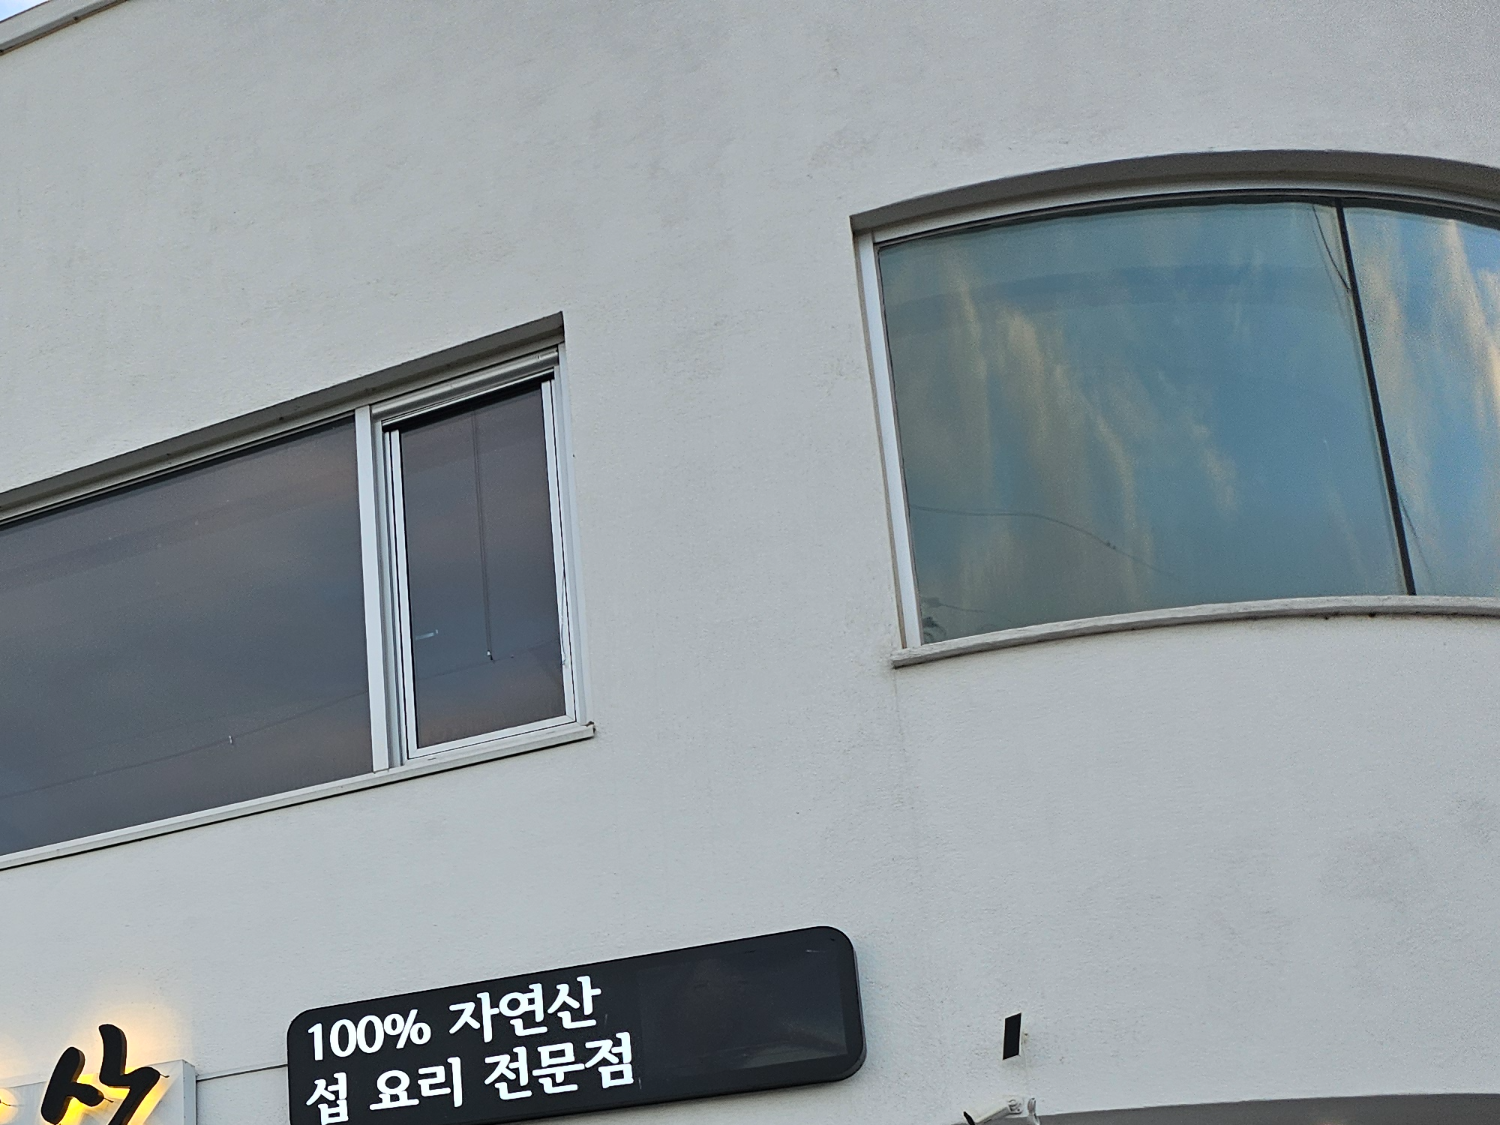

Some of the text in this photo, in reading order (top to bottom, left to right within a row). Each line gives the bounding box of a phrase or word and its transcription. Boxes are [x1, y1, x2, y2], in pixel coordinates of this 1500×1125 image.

[307, 975, 601, 1061] 100% 자연산
[306, 1031, 634, 1125] 섭 요리 전문점
